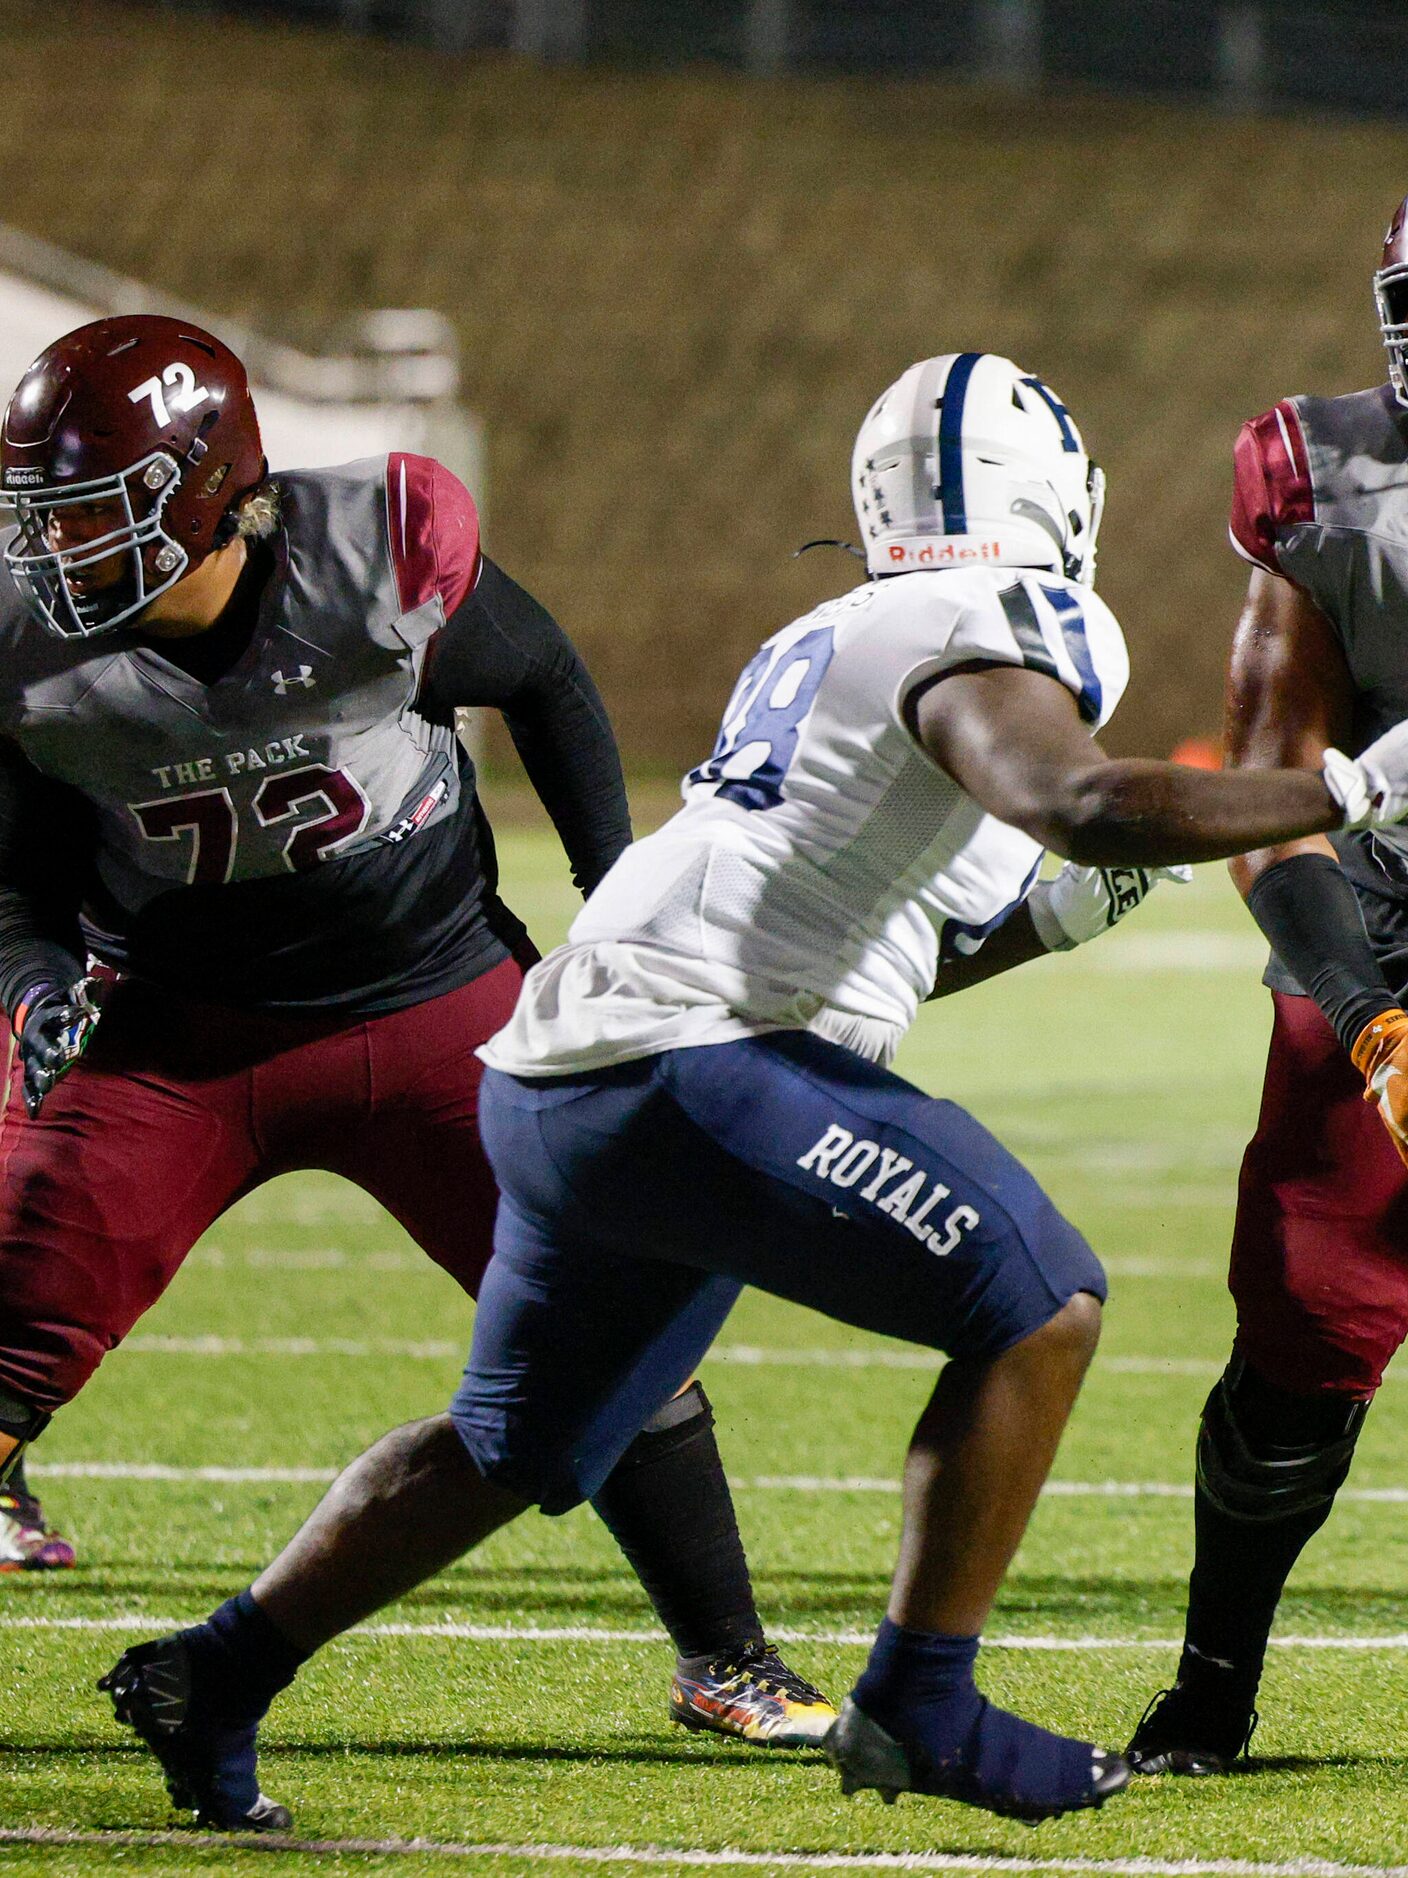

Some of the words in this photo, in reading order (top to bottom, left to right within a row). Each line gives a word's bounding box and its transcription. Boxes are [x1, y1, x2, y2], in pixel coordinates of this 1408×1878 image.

[127, 362, 210, 428] 72
[151, 758, 217, 789] THE
[225, 733, 310, 775] PACK
[127, 763, 372, 884] 72
[796, 1123, 980, 1256] ROYALS
